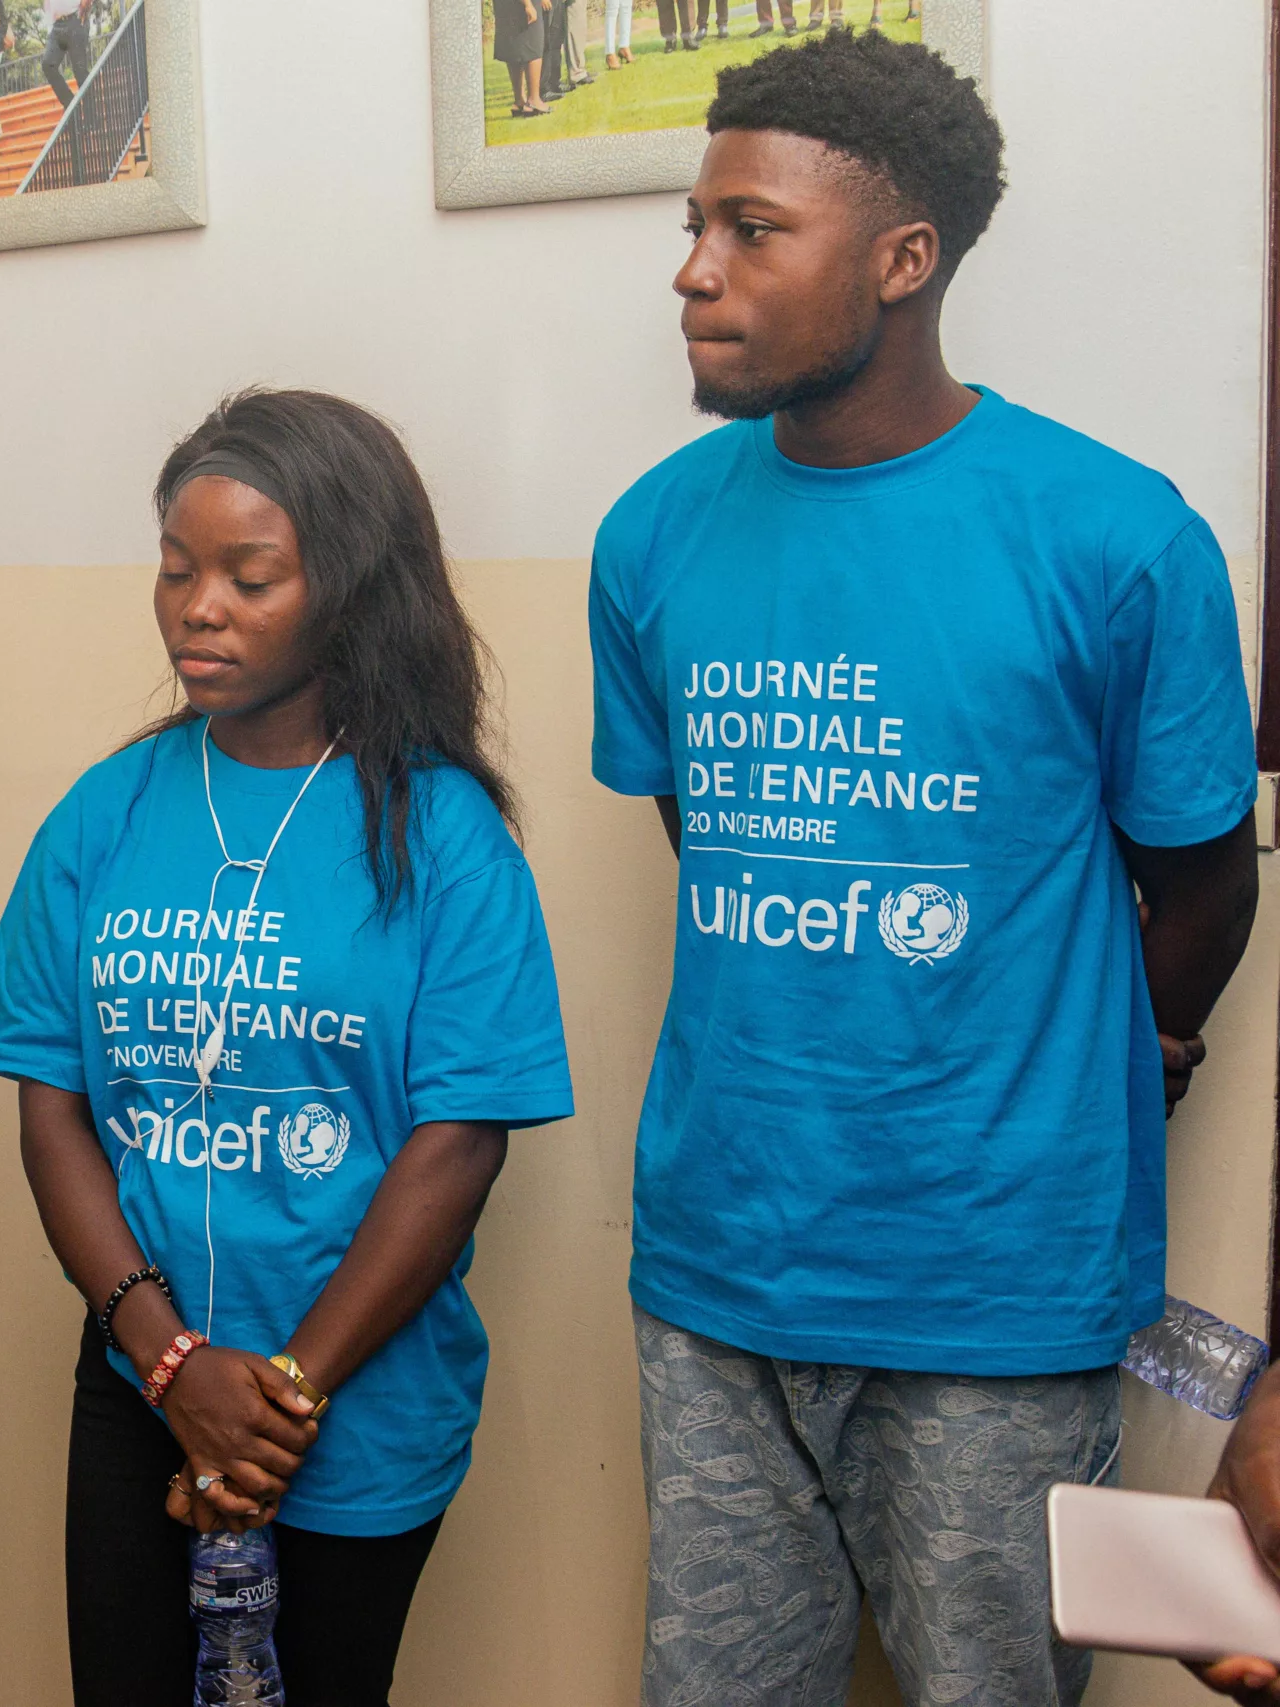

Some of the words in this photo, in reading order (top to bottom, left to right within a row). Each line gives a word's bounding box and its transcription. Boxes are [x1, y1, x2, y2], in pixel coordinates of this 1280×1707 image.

[684, 654, 878, 701] JOURNÉE
[686, 711, 903, 756] MONDIALE
[689, 761, 735, 797] DE
[687, 811, 711, 833] 20
[95, 903, 284, 944] JOURNÉE
[92, 950, 301, 991] MONDIALE
[97, 997, 129, 1034] DE
[147, 998, 366, 1049] L'ENFANCE
